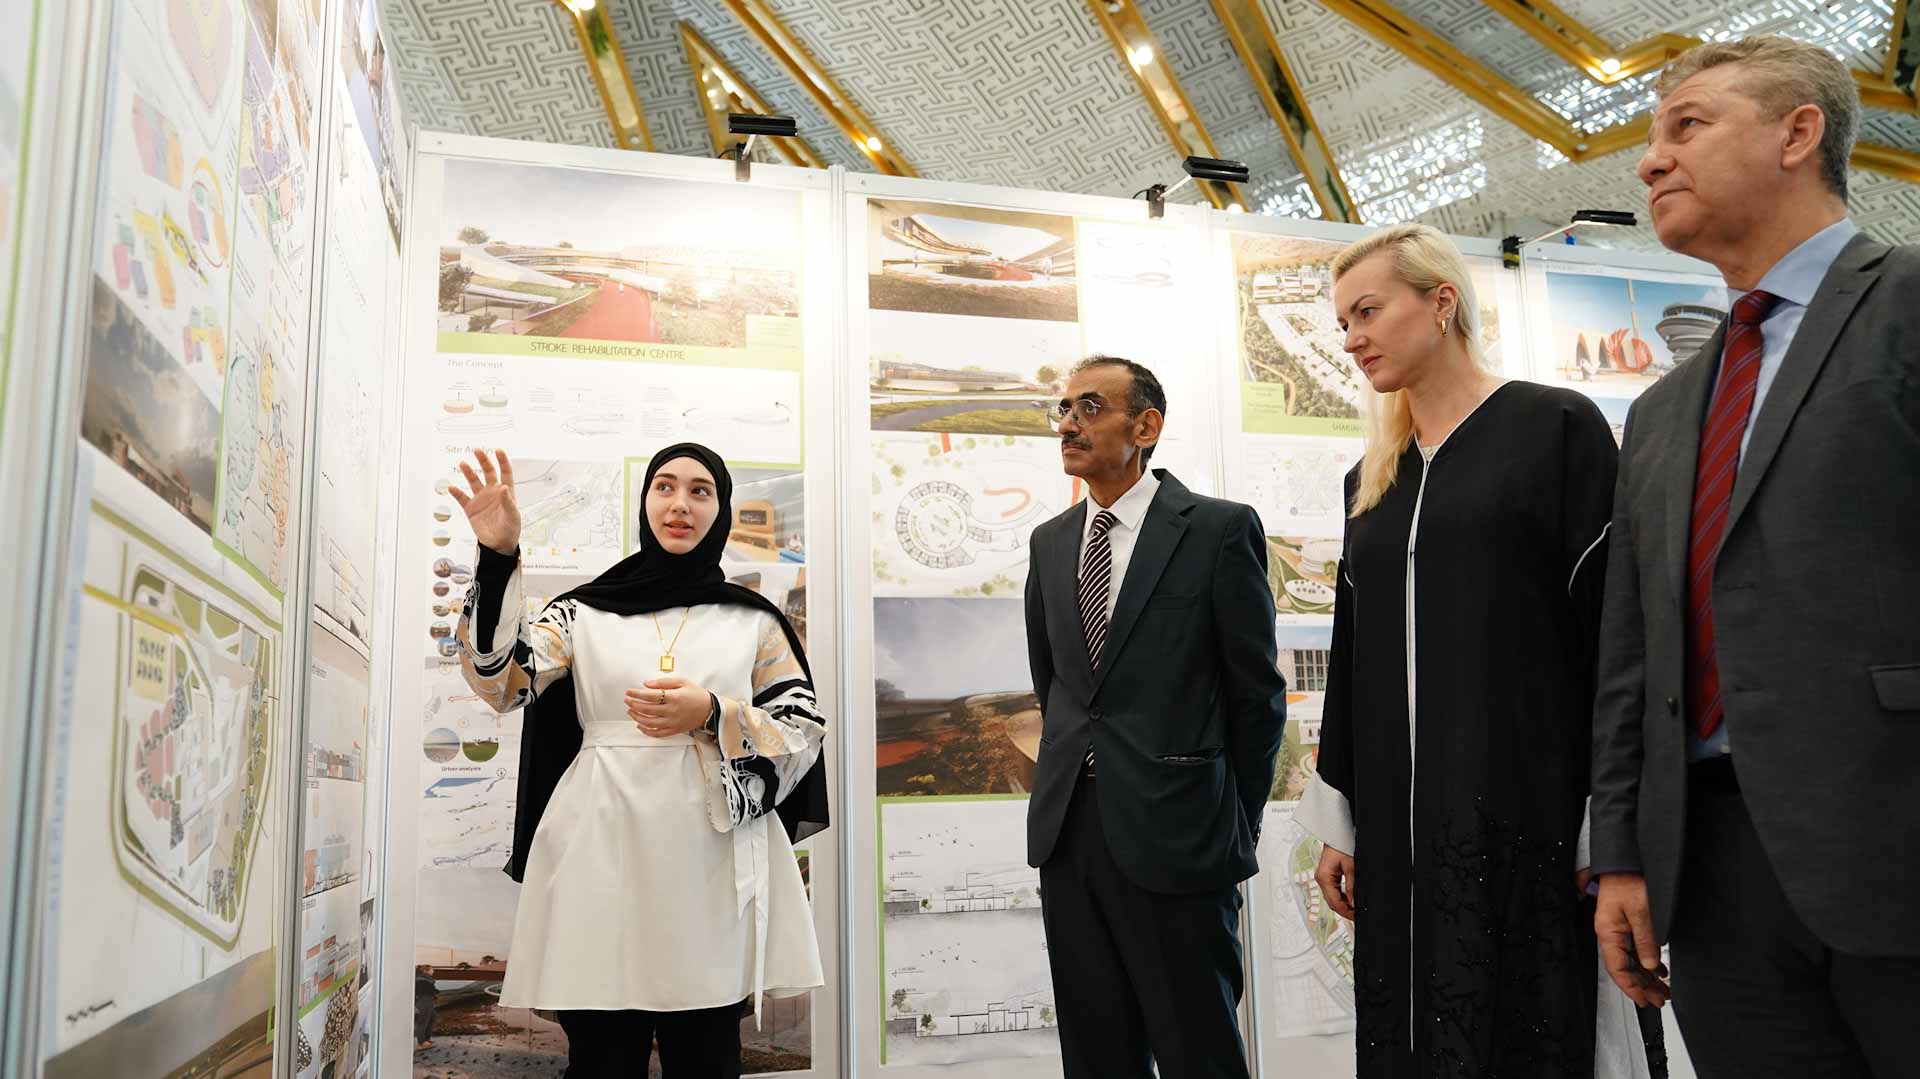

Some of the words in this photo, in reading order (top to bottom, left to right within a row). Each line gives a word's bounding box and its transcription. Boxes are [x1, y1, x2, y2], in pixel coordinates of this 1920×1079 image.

[530, 341, 567, 353] STROKE
[572, 343, 646, 357] REHABILITATION
[649, 348, 687, 360] CENTRE
[448, 359, 464, 367] The
[465, 359, 504, 369] Concept
